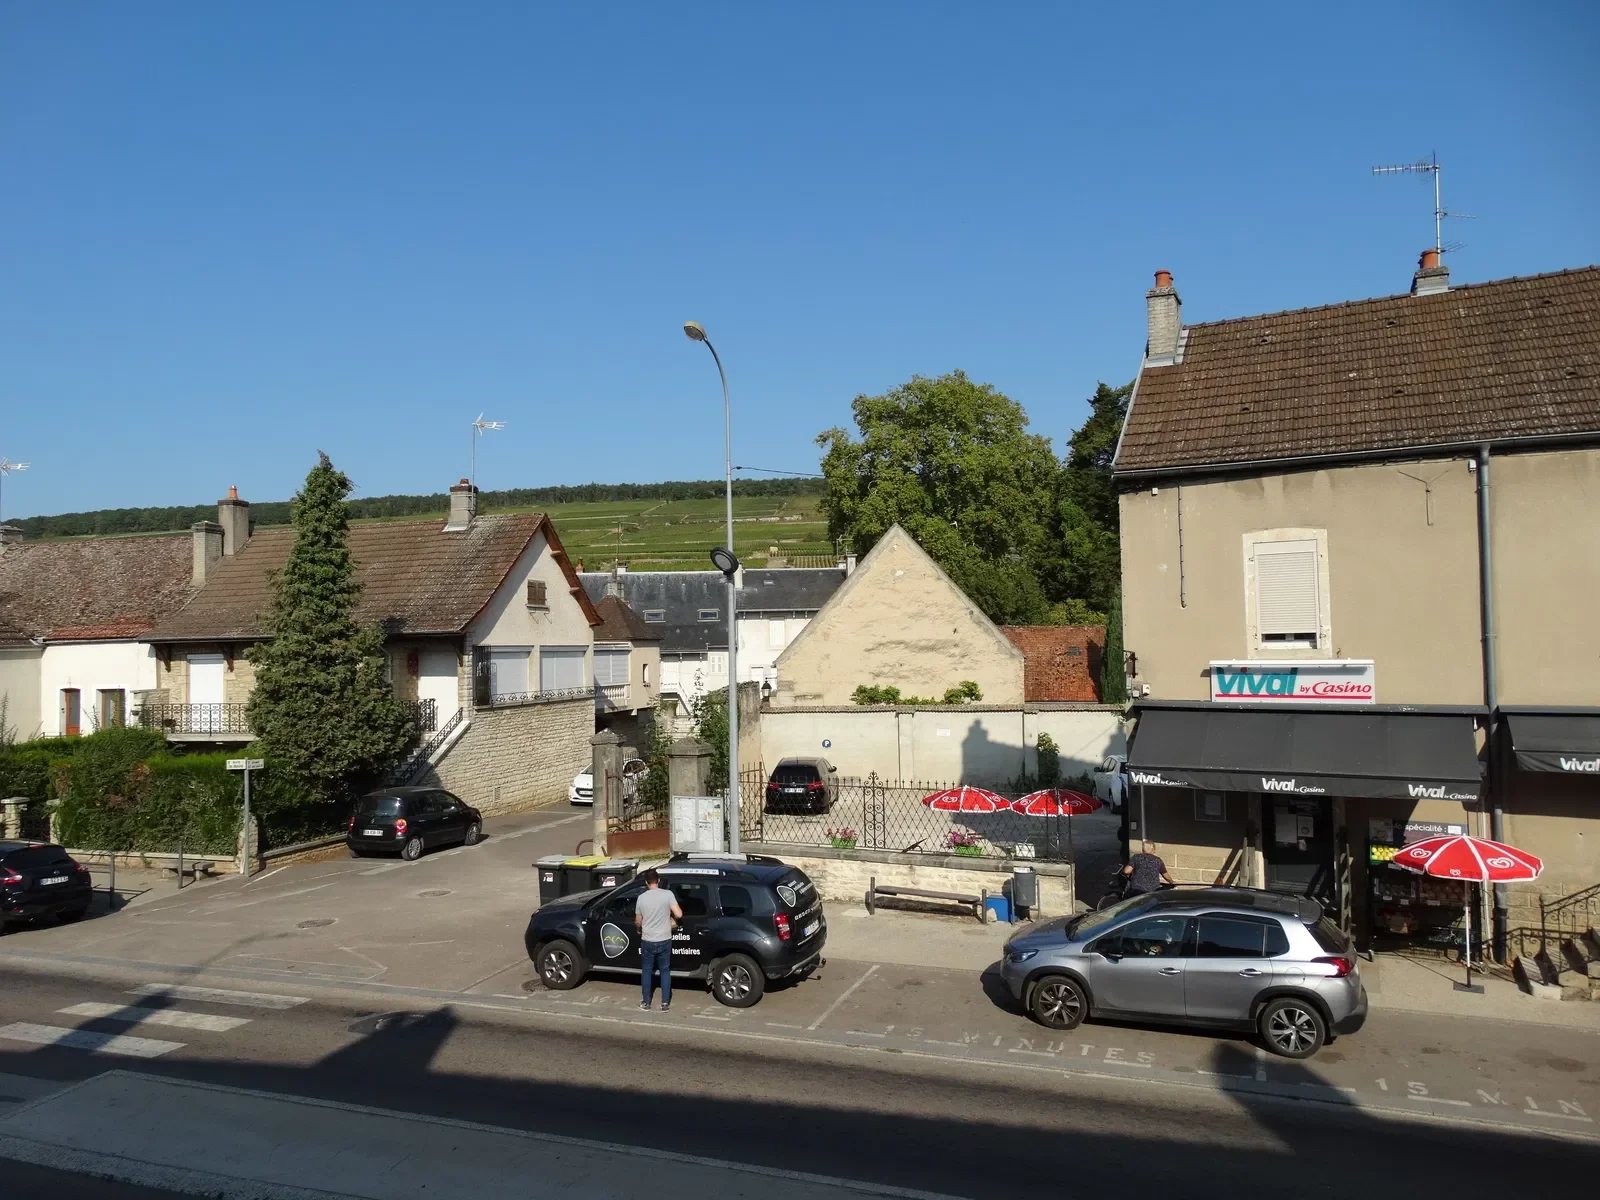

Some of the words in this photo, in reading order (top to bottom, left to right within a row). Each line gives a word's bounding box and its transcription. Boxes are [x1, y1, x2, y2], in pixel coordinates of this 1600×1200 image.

[1216, 667, 1299, 696] Vival
[1300, 685, 1311, 695] by
[1312, 681, 1372, 695] Casino
[1560, 757, 1600, 771] Vival
[1261, 777, 1295, 792] Vival
[1300, 786, 1326, 794] Casino
[1408, 784, 1446, 799] Vival
[1405, 824, 1443, 832] spécialité
[672, 947, 700, 955] tertiaires
[1374, 1078, 1429, 1096] 15
